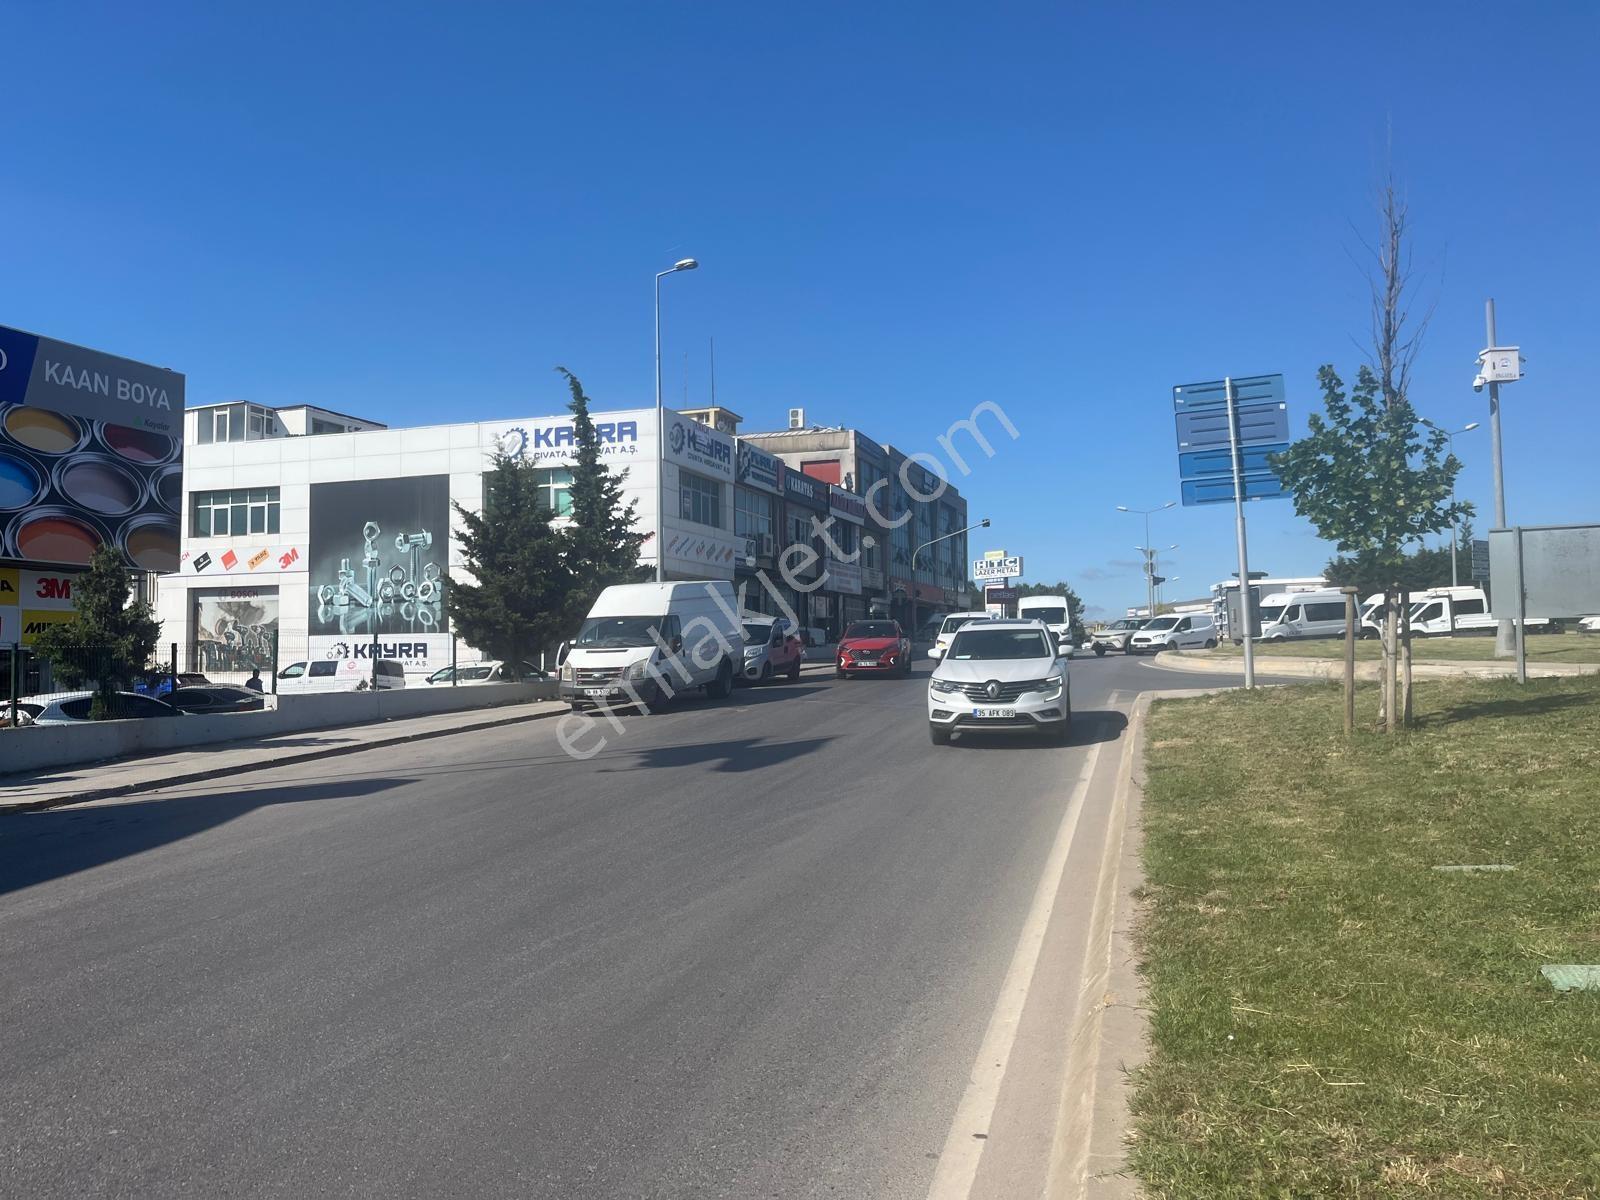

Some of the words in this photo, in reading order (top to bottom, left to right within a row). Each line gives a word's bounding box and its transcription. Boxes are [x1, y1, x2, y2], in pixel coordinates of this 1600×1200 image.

[45, 360, 109, 396] KAAN
[117, 378, 171, 411] BOYA
[534, 421, 638, 449] KARA
[278, 547, 300, 569] 3M
[36, 578, 71, 599] 3M
[354, 643, 428, 659] KAYRA
